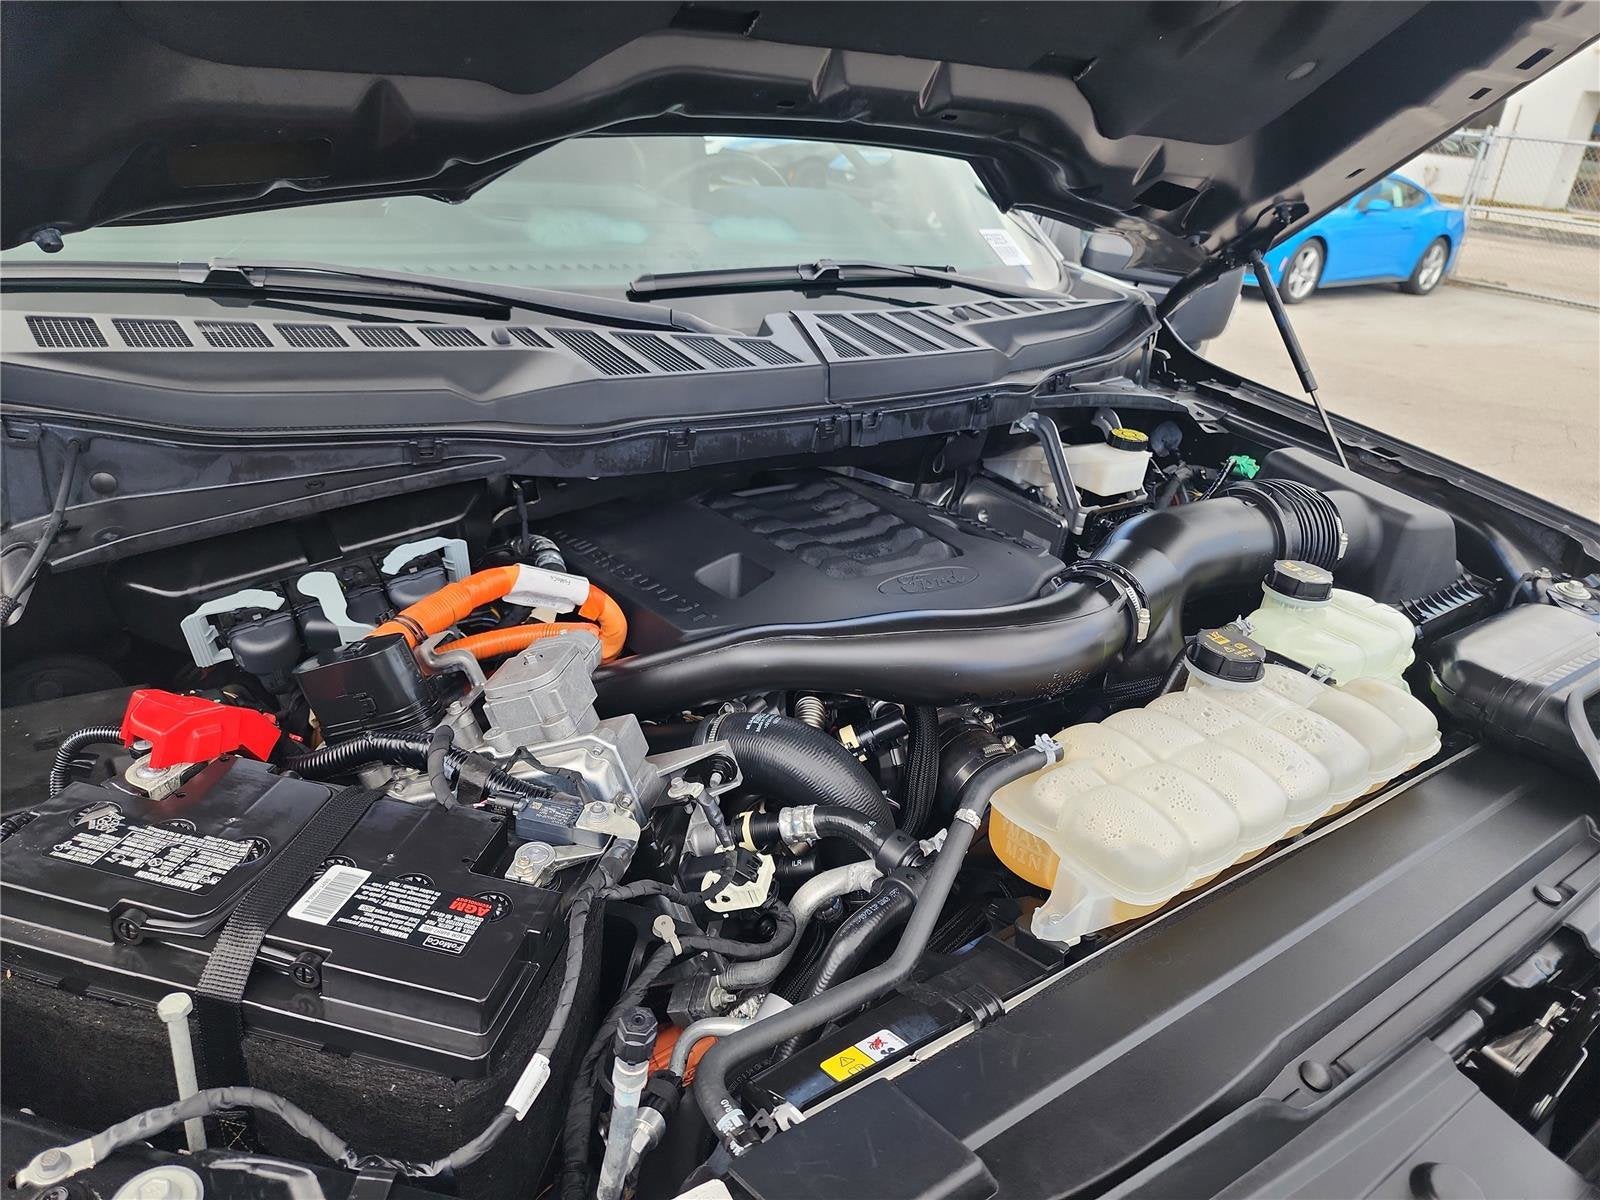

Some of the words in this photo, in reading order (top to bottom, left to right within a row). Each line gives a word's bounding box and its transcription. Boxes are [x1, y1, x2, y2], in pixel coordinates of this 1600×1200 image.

[897, 570, 966, 594] Ford
[448, 902, 491, 916] AGM
[428, 938, 464, 951] FoMoCo
